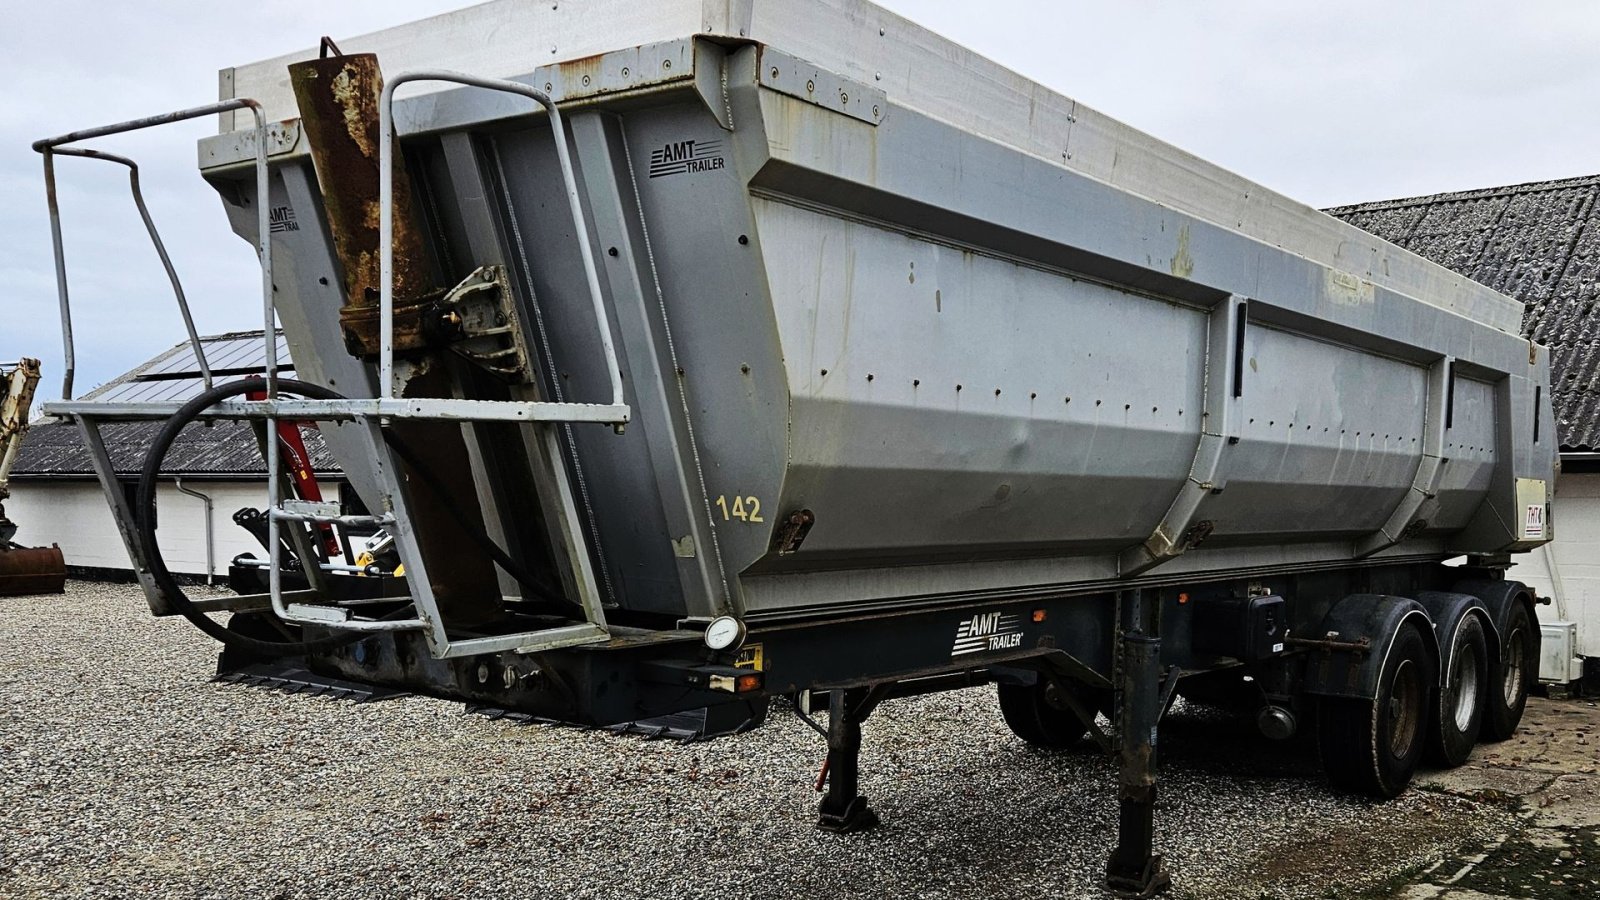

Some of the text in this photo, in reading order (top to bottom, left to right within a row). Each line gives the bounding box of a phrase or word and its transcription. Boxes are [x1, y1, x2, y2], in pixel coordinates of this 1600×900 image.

[663, 140, 695, 162] AMT
[687, 158, 725, 173] TRAILER
[716, 495, 764, 522] 142
[969, 612, 1001, 636] AMT
[988, 632, 1021, 650] TRAILER
